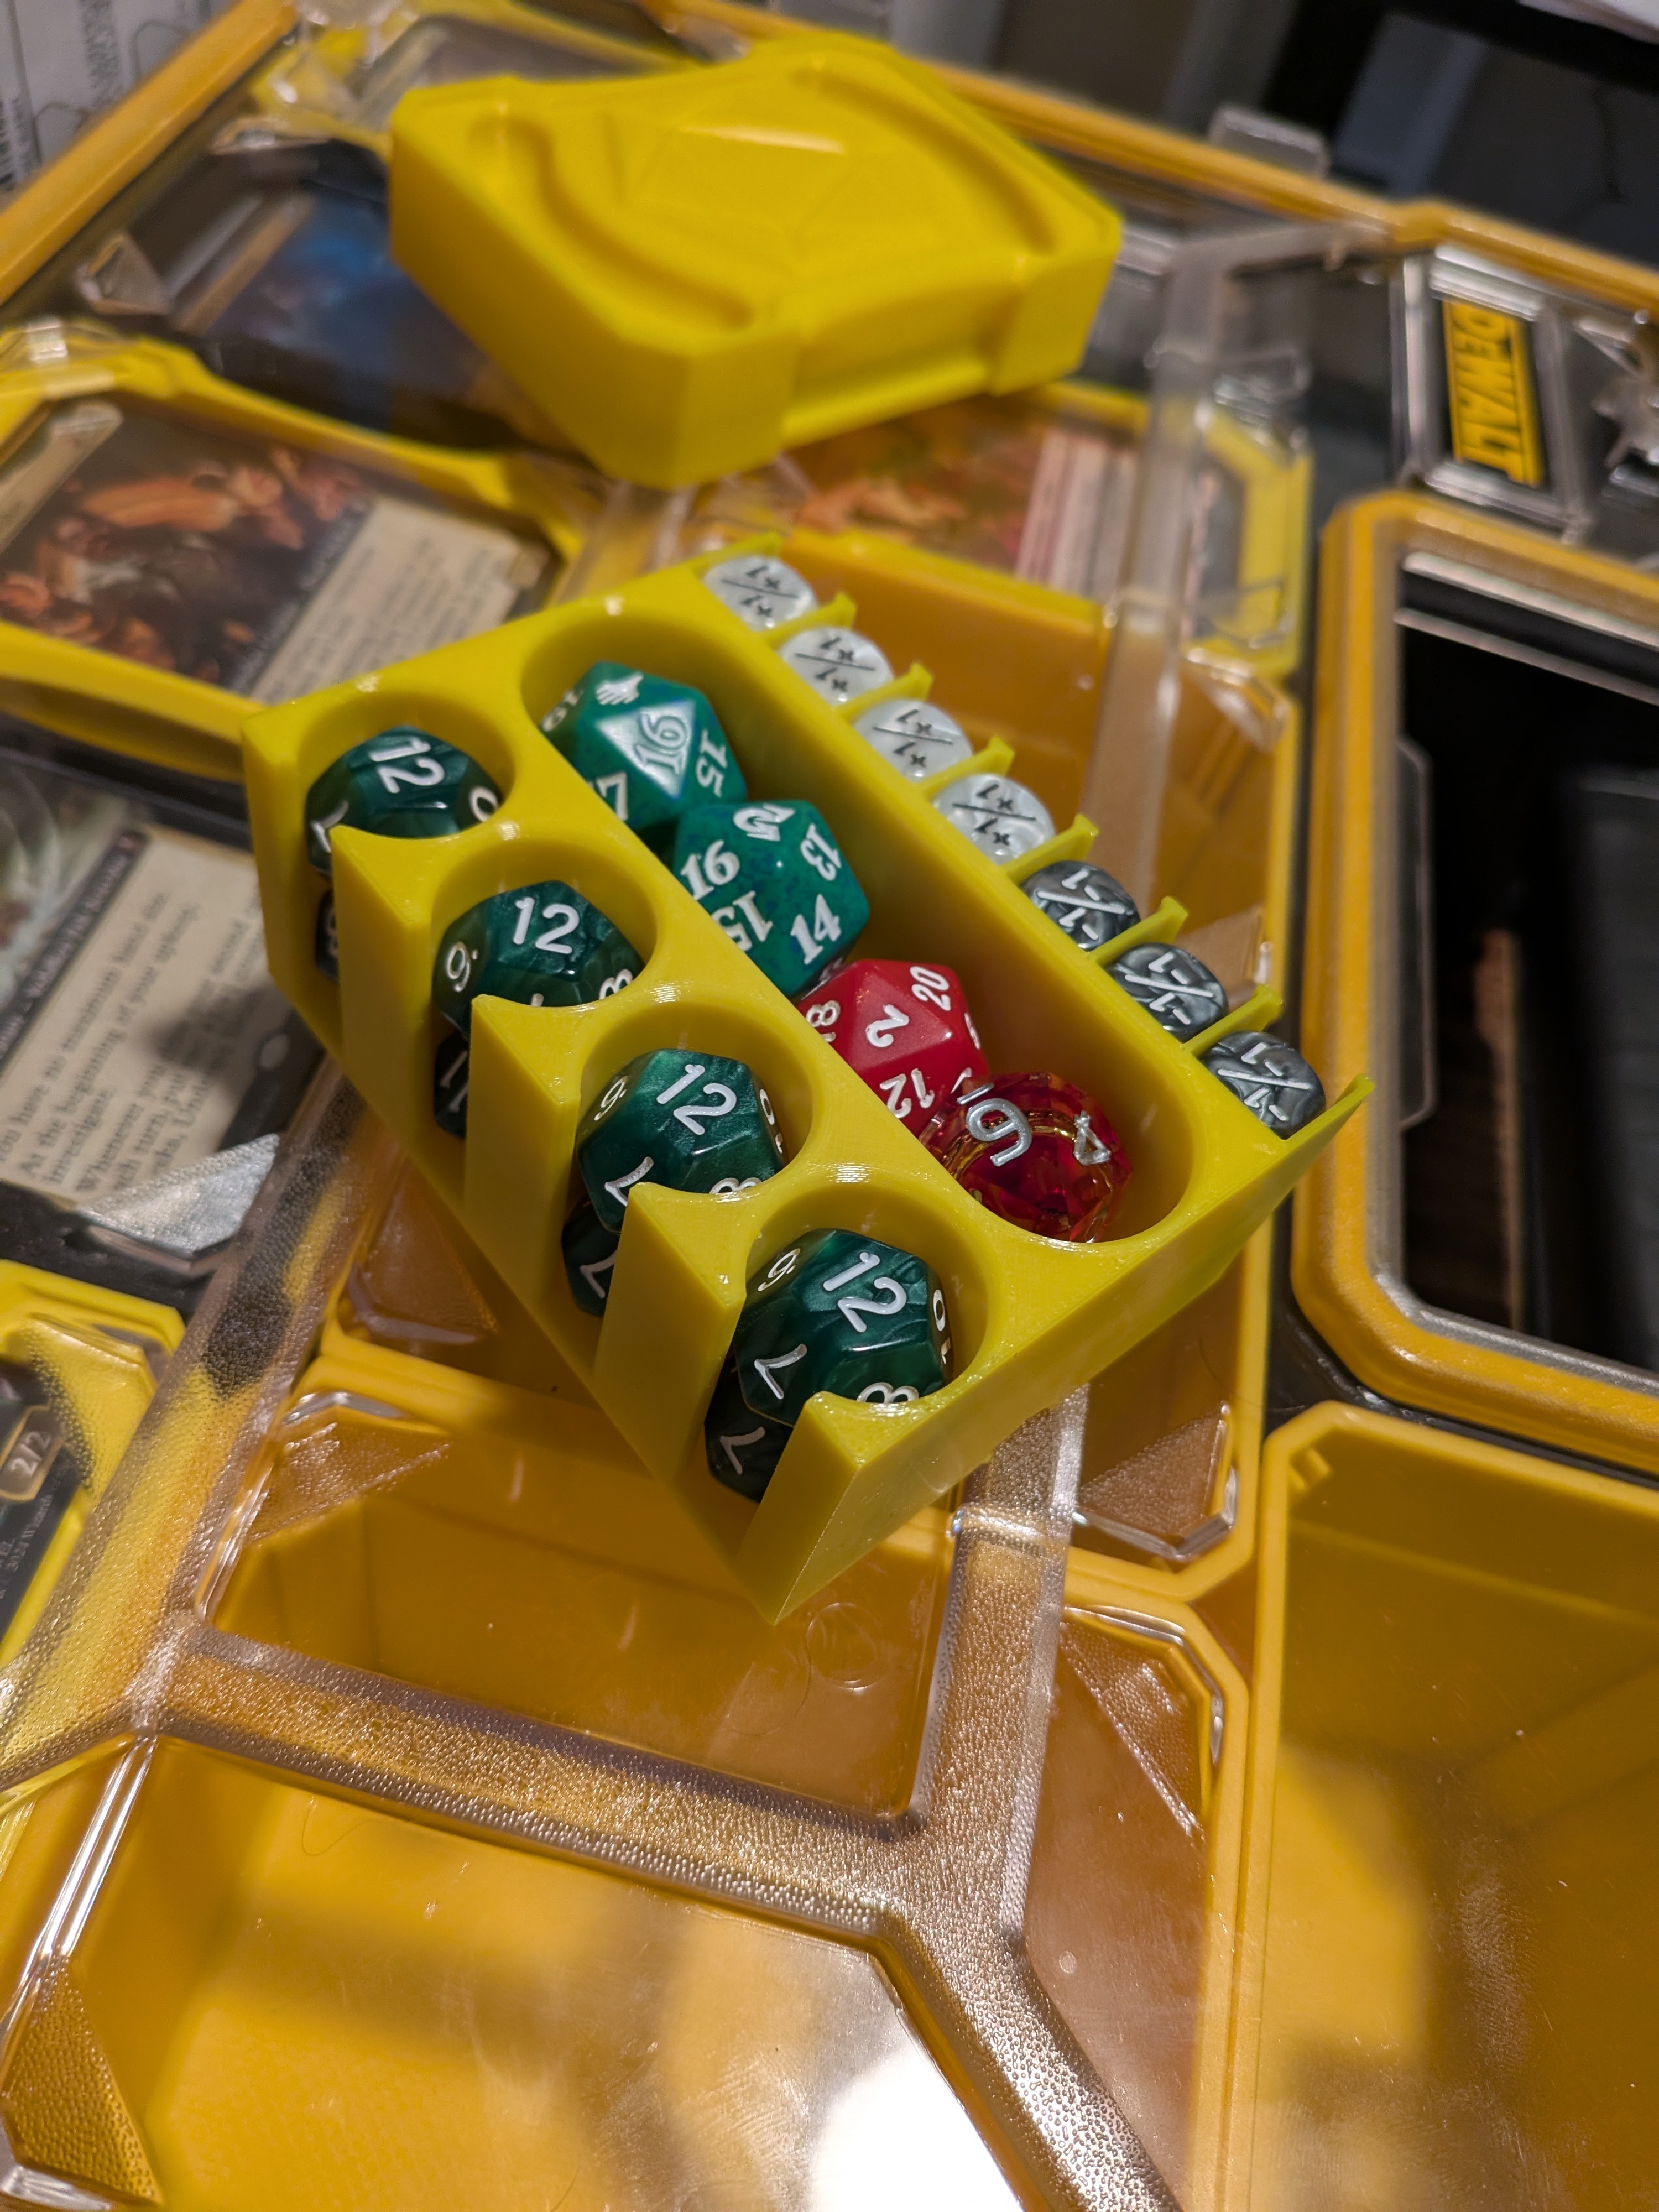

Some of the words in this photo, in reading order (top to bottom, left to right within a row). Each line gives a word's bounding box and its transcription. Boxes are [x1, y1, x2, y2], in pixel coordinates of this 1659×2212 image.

[1452, 305, 1522, 478] DEWALT
[369, 737, 445, 794] 12
[633, 711, 688, 774] 16
[696, 729, 728, 798] 15
[680, 839, 740, 900] 16
[800, 823, 841, 881] 13
[513, 897, 580, 954] 12
[711, 890, 774, 952] 15
[790, 894, 841, 965] 14
[910, 966, 952, 1011] 20
[866, 1005, 909, 1048] 2
[20, 1151, 46, 1176] At
[36, 1117, 66, 1149] the
[56, 1026, 127, 1117] beginning
[656, 1065, 737, 1135] 12
[880, 1068, 935, 1119] 12
[74, 1102, 145, 1195] Whenever
[823, 1252, 907, 1333] 12
[754, 1344, 807, 1400] 7
[10, 1430, 51, 1477] 2/2
[720, 1426, 765, 1475] 7
